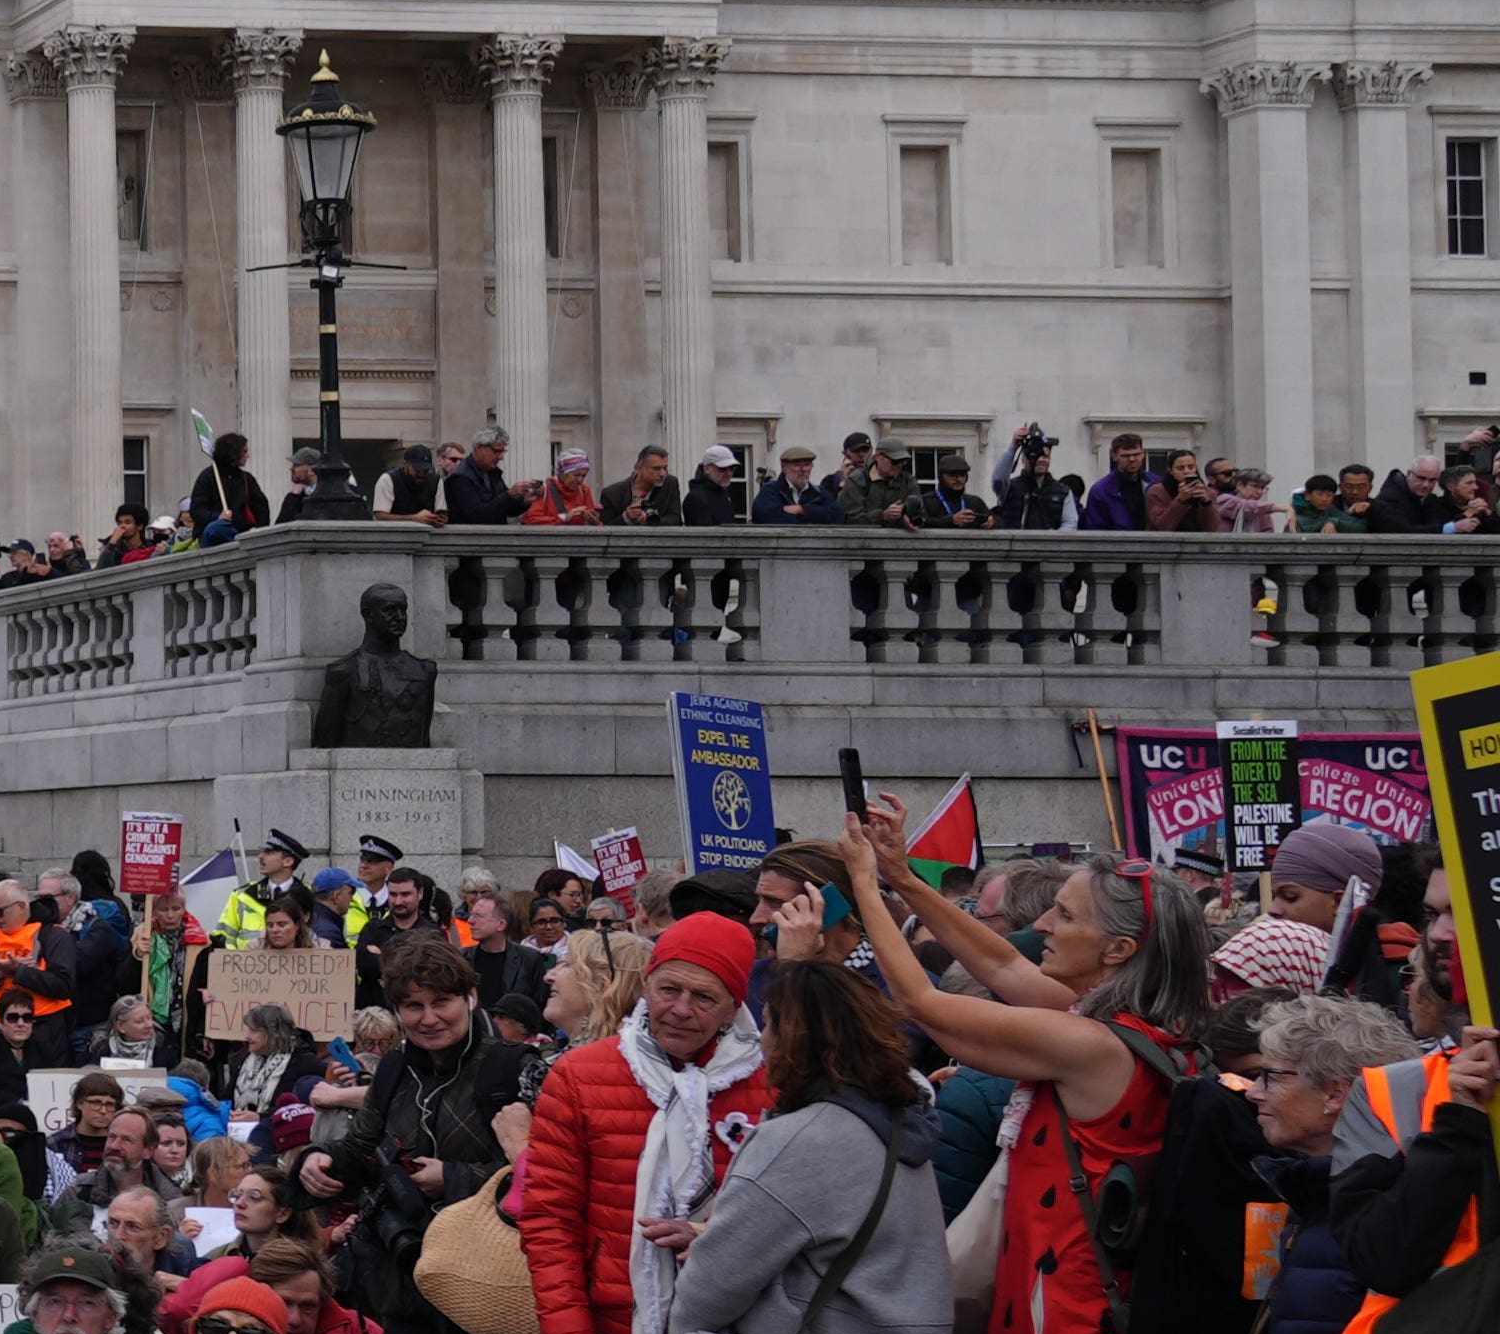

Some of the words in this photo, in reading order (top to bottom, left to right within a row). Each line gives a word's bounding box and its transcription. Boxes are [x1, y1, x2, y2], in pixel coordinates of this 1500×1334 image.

[690, 695, 711, 707] JEWS
[713, 697, 750, 711] AGAINST
[681, 709, 713, 723] ETHNIC
[715, 712, 761, 729] CLEANSING
[698, 729, 729, 747] EXPEL
[730, 733, 750, 749] THE
[1230, 741, 1263, 761] FROM
[1265, 741, 1287, 760] THE
[1232, 762, 1264, 782] RIVER
[1266, 762, 1281, 781] TO
[341, 788, 455, 802] CUNNINGHAM
[1232, 783, 1254, 803] THE
[1257, 783, 1277, 802] SEA
[1297, 761, 1360, 786] College
[1375, 780, 1423, 813] Union
[1157, 790, 1224, 834] LON
[1234, 804, 1293, 824] PALESTINE
[1310, 780, 1421, 842] REGION
[126, 822, 142, 832] IT'S
[144, 823, 160, 833] NOT
[162, 824, 169, 834] A
[126, 832, 152, 843] CRIME
[154, 834, 165, 844] TO
[1234, 825, 1262, 845] WILL
[1265, 825, 1279, 844] BE
[125, 843, 141, 853] ACT
[142, 844, 177, 855] AGAINST
[702, 834, 714, 846] UK
[715, 836, 767, 852] POLITICIANS:
[125, 853, 165, 865] GENOCIDE
[700, 852, 722, 865] STOP
[1236, 846, 1264, 867] FREE
[231, 977, 271, 994] SHOW
[289, 977, 330, 995] YOUR
